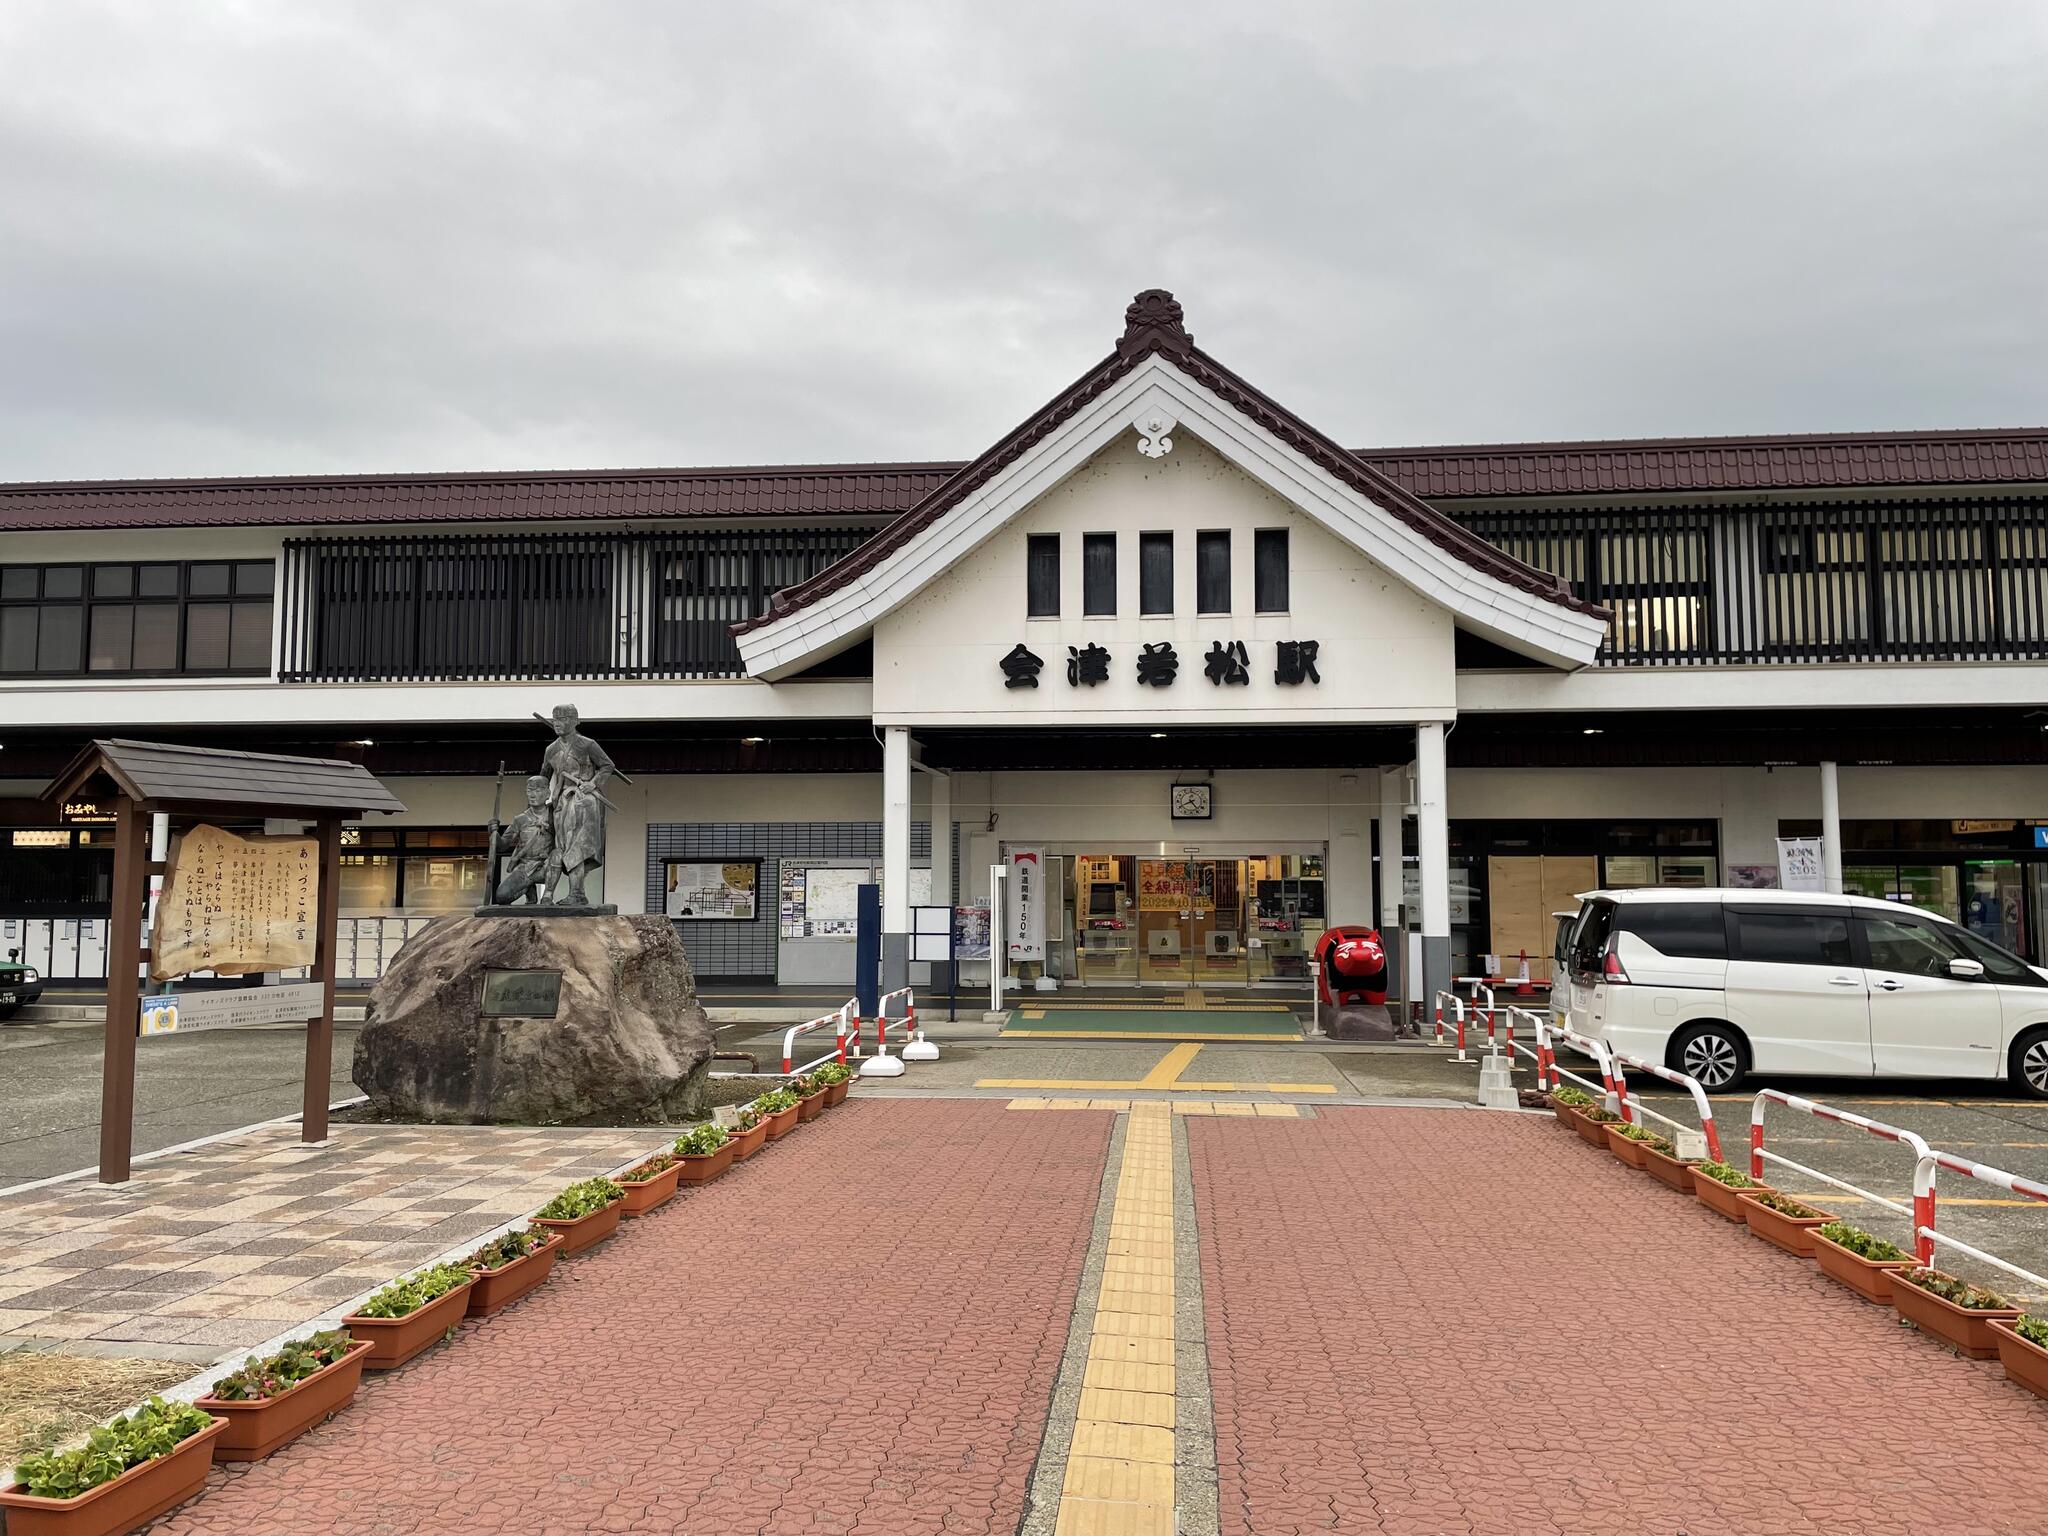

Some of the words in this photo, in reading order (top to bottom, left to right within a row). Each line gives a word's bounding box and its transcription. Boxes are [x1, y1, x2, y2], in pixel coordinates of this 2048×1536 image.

[999, 641, 1321, 689] 会津若松駅
[195, 844, 205, 905] ならぬことは
[213, 843, 224, 912] やってはならぬ
[296, 847, 308, 940] あいづっこ宣言
[1019, 867, 1029, 940] 鉄道開業150年
[183, 875, 193, 949] ならぬものです
